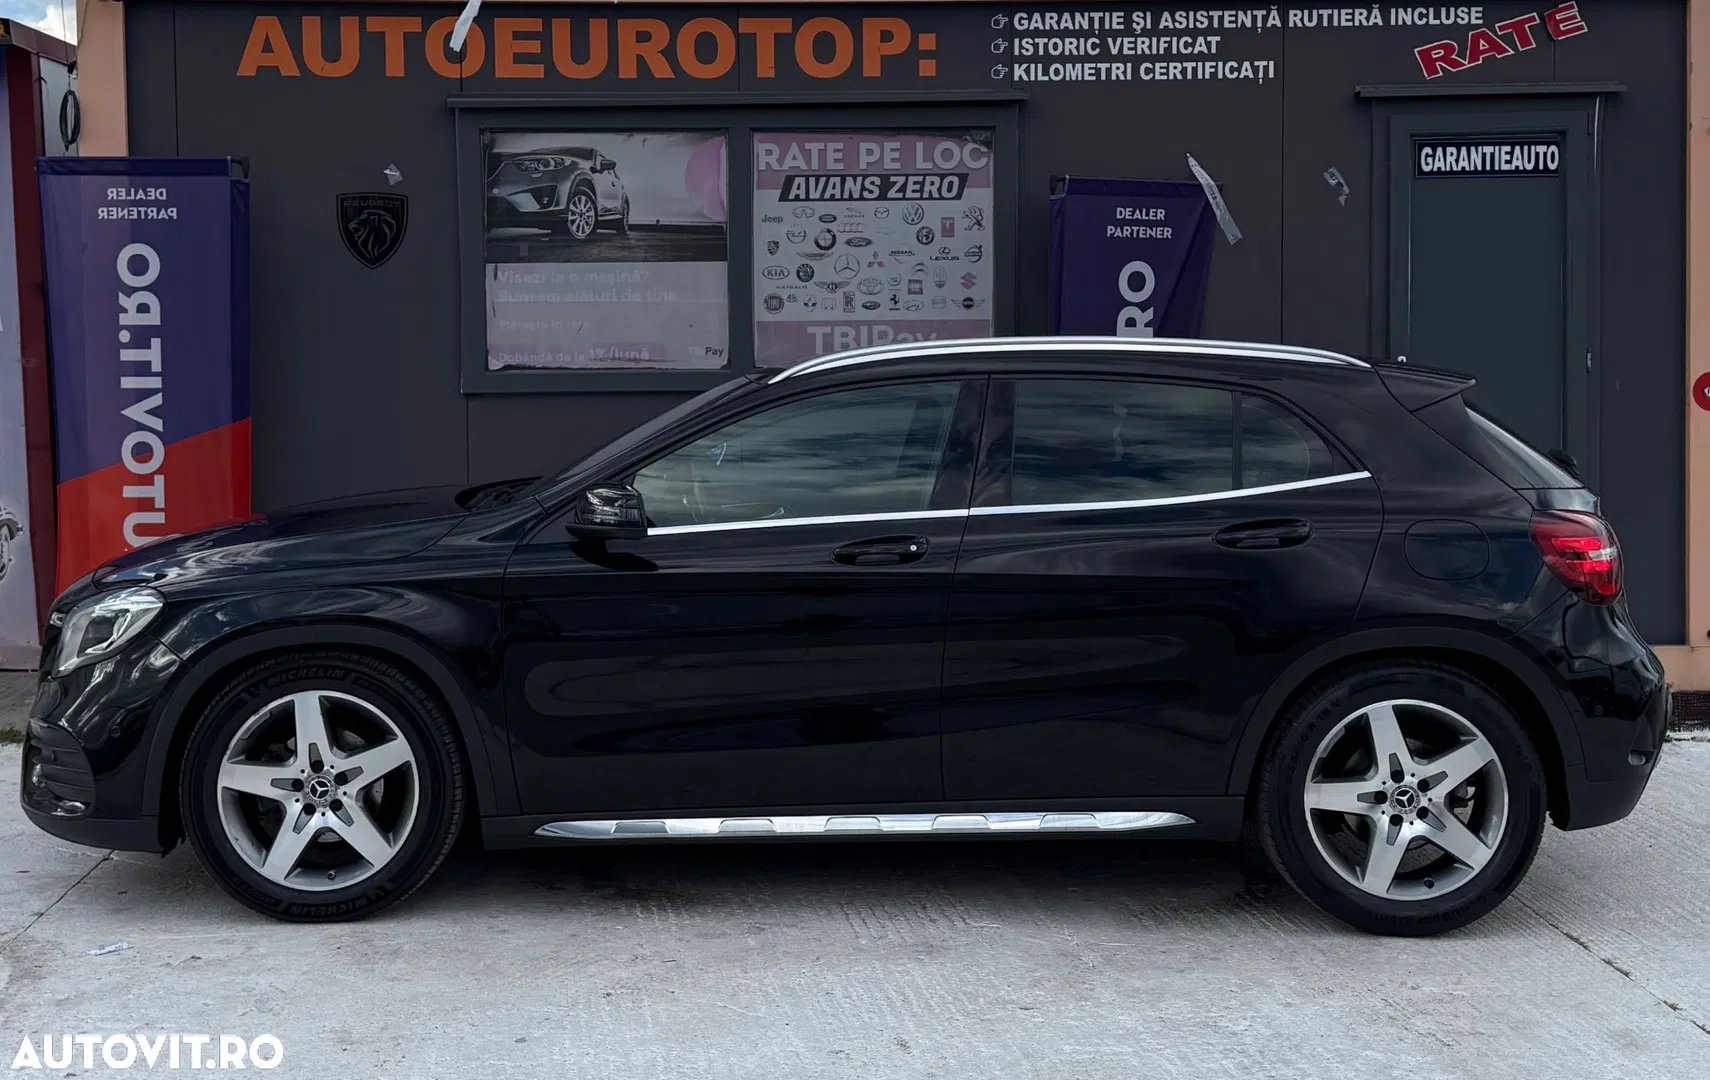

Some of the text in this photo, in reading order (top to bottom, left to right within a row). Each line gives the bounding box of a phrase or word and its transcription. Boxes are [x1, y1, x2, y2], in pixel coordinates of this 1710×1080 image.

[1288, 4, 1383, 27] RUTIERĂ
[1390, 7, 1484, 25] INCLUSE
[237, 16, 936, 79] AUTOEUROTOP:
[1013, 36, 1221, 56] ISTORIC VERIFICAT
[1414, 1, 1588, 80] RATE
[1013, 62, 1132, 81] KILOMETRI
[758, 141, 988, 170] RATE PE LOC
[1420, 145, 1559, 172] GARANTIEAUTO
[788, 175, 960, 200] AVANS ZERO
[762, 214, 784, 224] Jeep
[1116, 207, 1165, 220] DEALER
[1106, 225, 1172, 239] PARTENER
[766, 268, 786, 277] KIA
